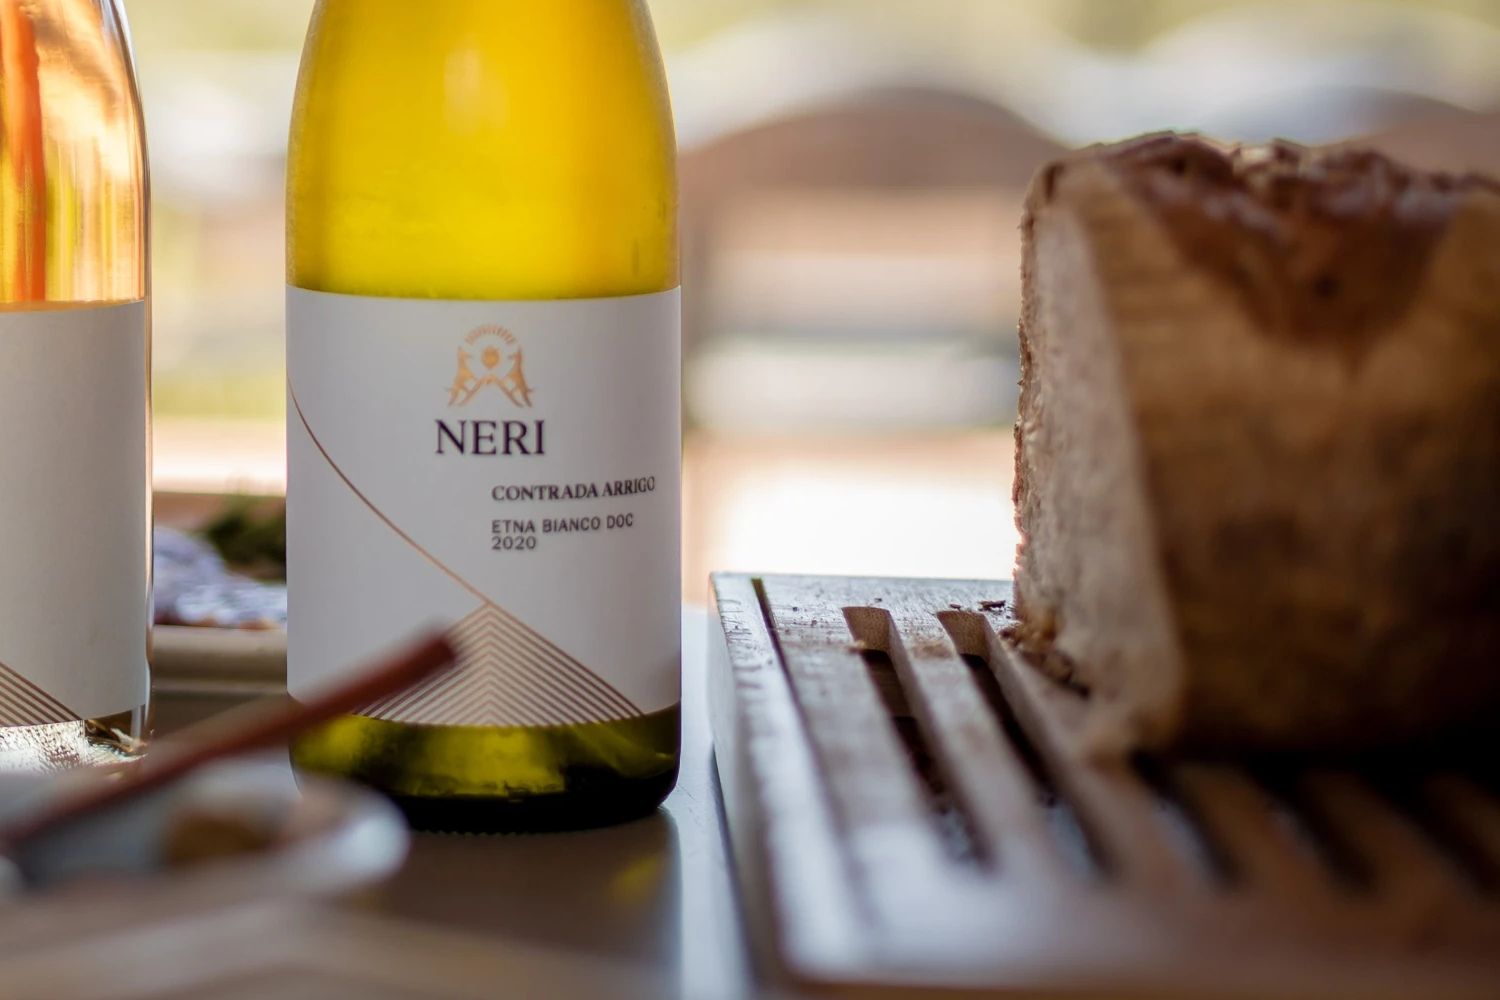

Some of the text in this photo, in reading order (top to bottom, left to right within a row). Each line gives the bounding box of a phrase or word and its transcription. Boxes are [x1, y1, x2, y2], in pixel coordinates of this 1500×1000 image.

[435, 419, 545, 455] NERI
[491, 476, 655, 501] CONTRADA ARRIGO
[491, 513, 634, 534] ETNA BIANCO DOC
[491, 536, 537, 550] 2020
